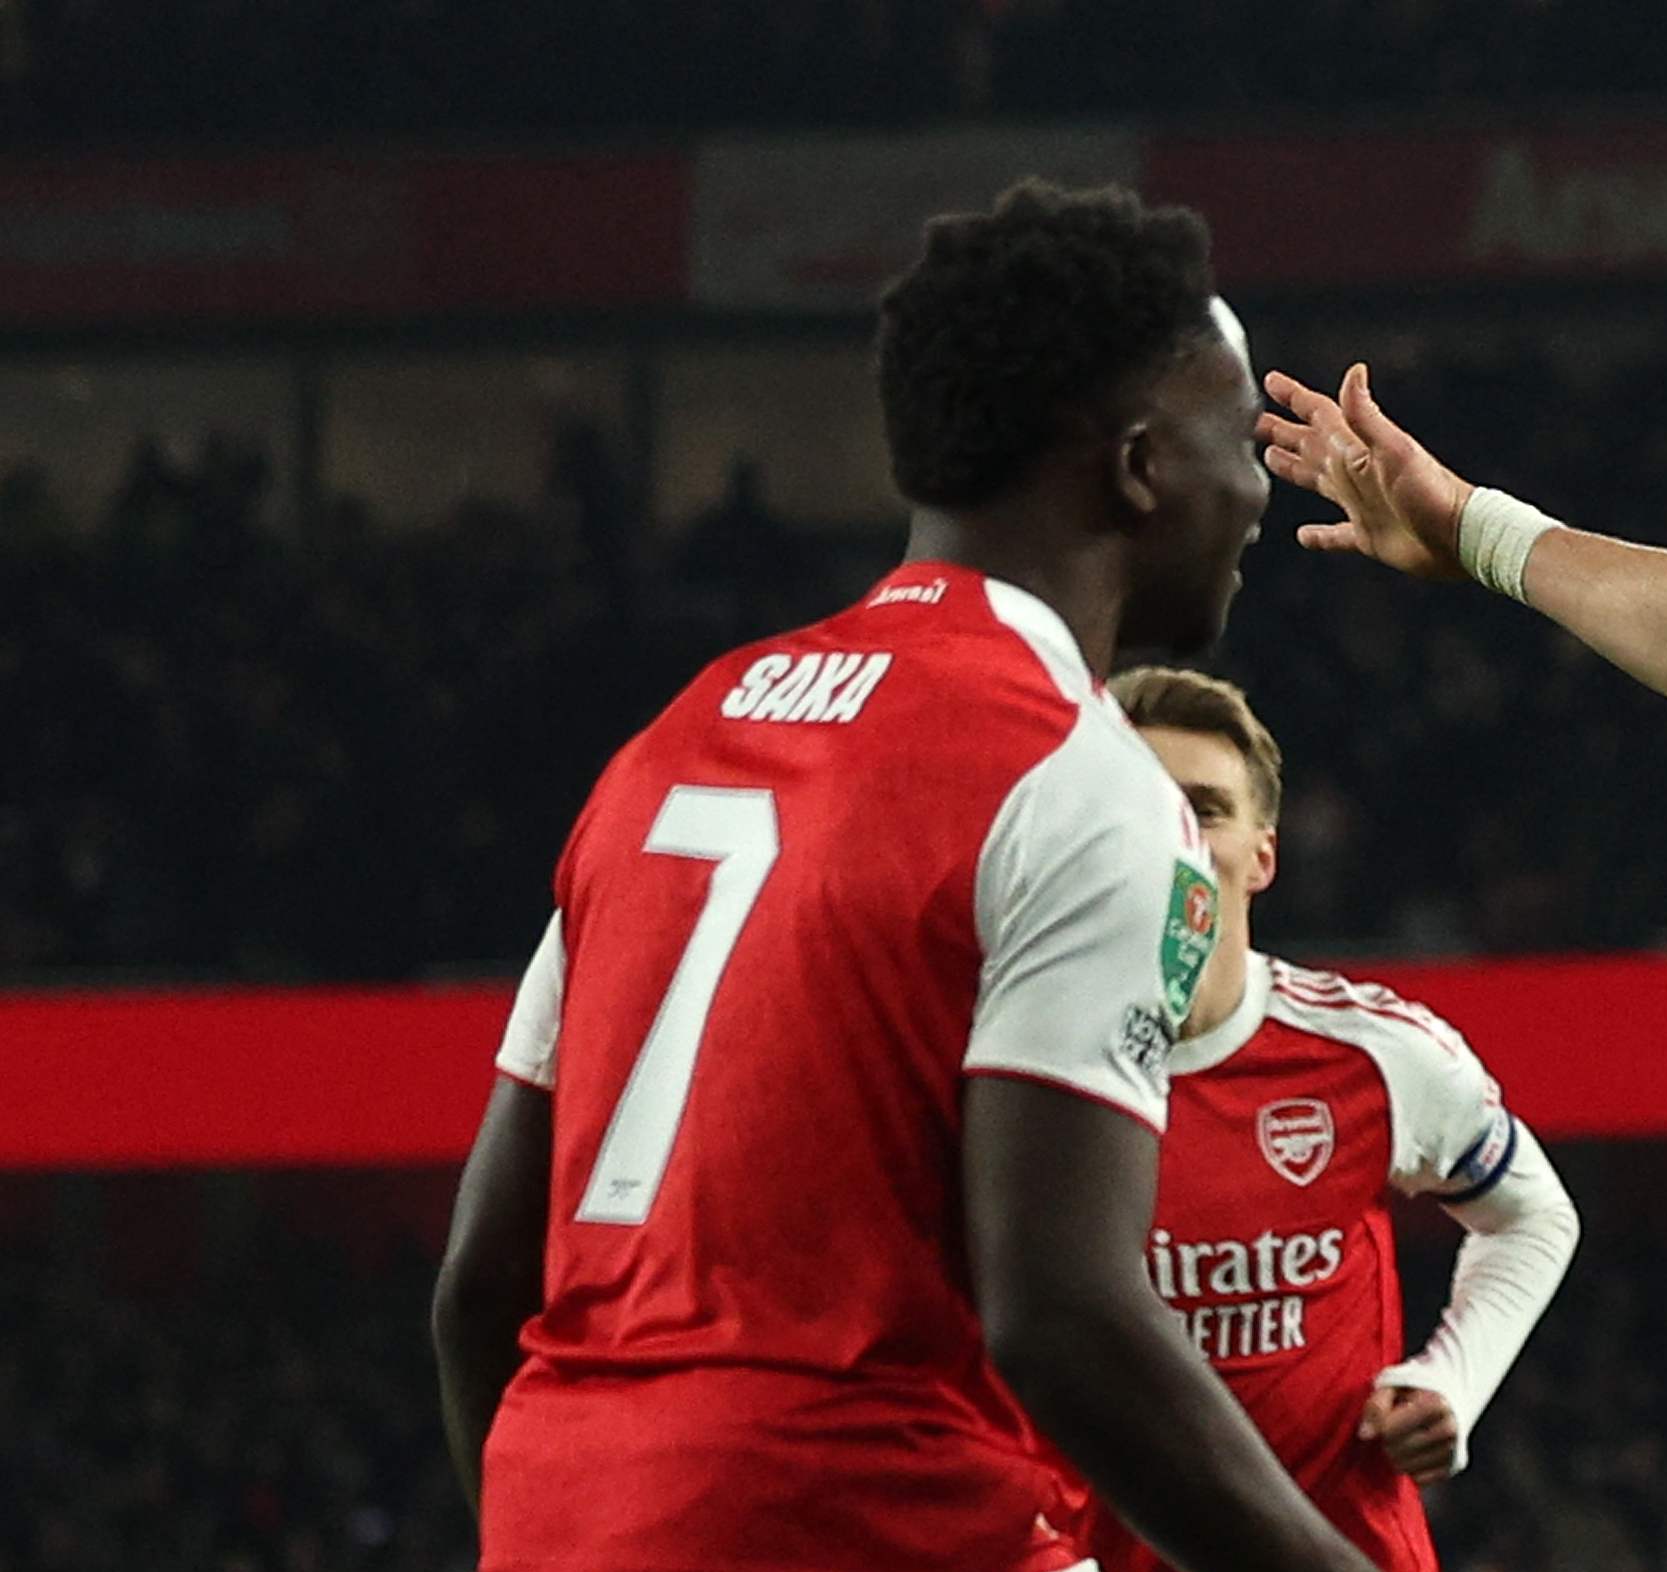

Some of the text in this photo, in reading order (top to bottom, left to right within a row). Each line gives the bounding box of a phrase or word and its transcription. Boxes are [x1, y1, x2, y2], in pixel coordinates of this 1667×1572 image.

[720, 653, 893, 723] SAKA
[573, 784, 781, 1225] 7
[1151, 1228, 1344, 1299] irates
[1193, 1296, 1306, 1358] ETTER
